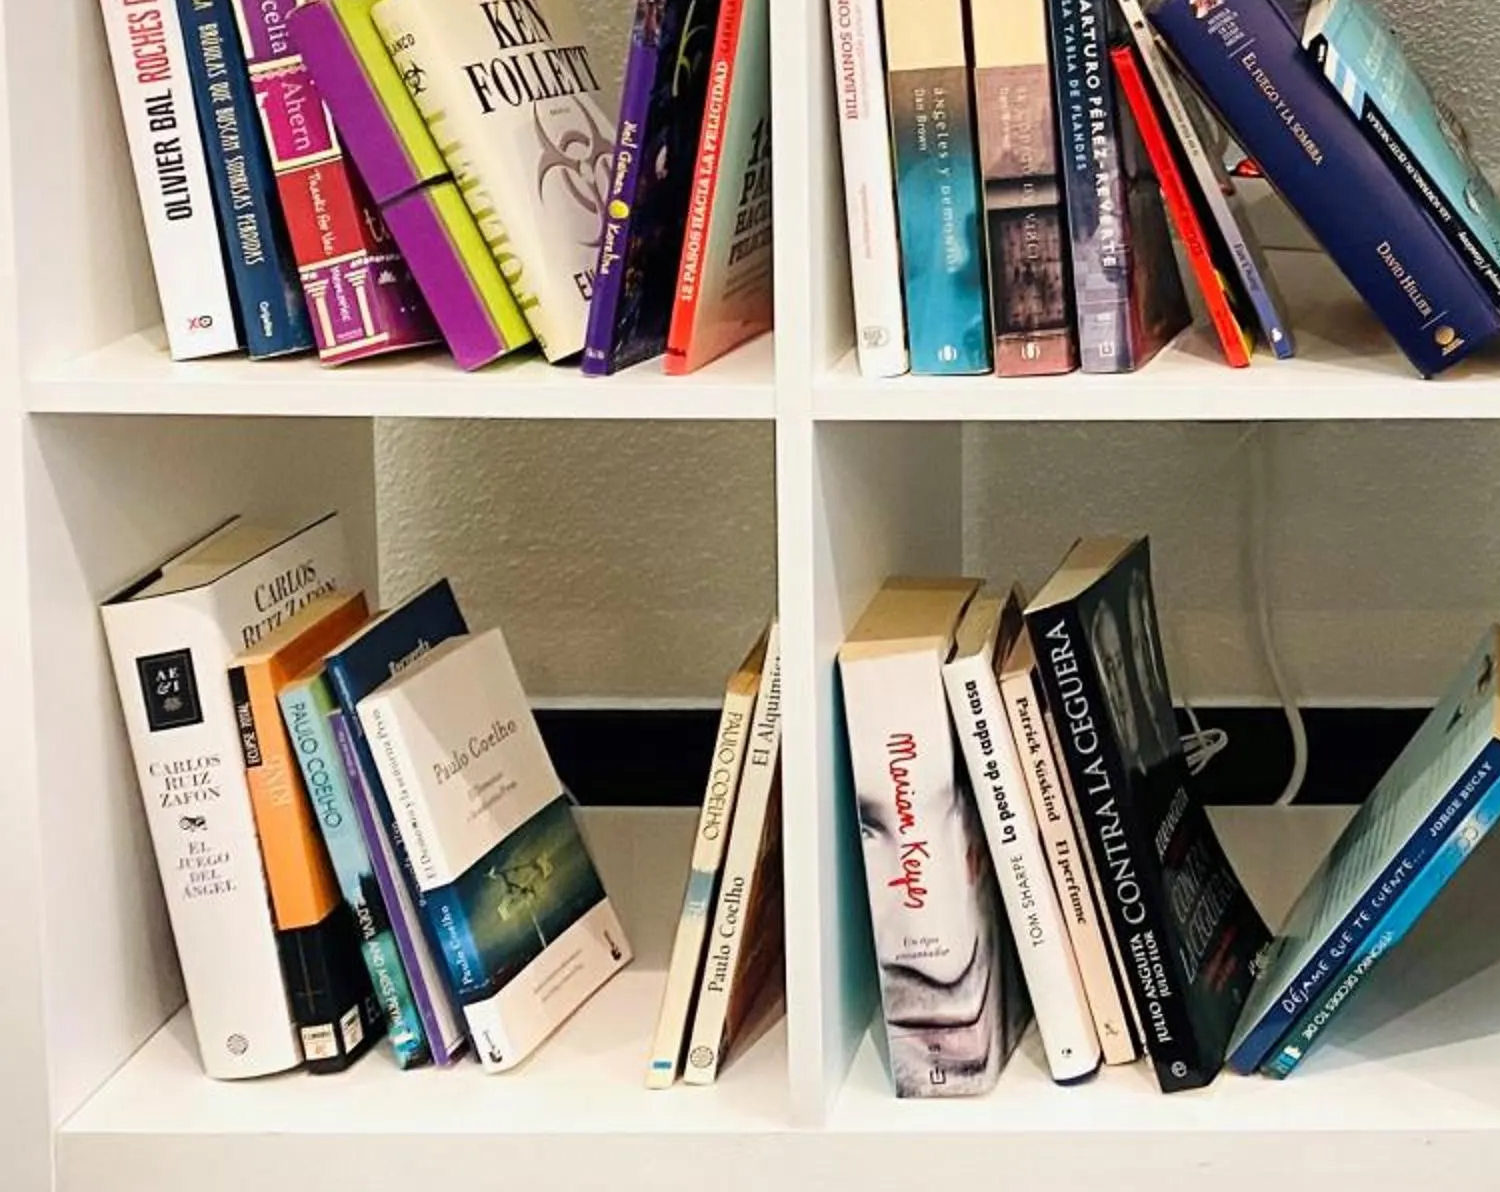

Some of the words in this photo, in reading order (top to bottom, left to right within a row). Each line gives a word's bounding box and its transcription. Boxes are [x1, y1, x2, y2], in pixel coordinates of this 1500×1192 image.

[1061, 0, 1073, 18] LA
[128, 9, 172, 84] ROCHES
[1063, 23, 1078, 73] TABLA
[1079, 0, 1100, 90] ARTURO
[463, 46, 601, 115] FOLLETT
[840, 32, 859, 120] BILBAINOS
[914, 88, 926, 112] Dan
[1068, 79, 1081, 98] DE
[145, 88, 177, 132] BAL
[281, 82, 311, 151] Ahern
[704, 61, 728, 151] FELICIDAD
[915, 115, 929, 151] Brown
[1250, 67, 1281, 103] FUEGO
[1278, 107, 1296, 125] LA
[1288, 121, 1325, 165] SOMBRA
[701, 147, 715, 178] LA
[1071, 105, 1087, 171] FLANDES
[154, 137, 193, 221] OLIVIER
[690, 178, 710, 233] HACIA
[1089, 95, 1117, 267] PÉREZ-REVERTE
[682, 230, 701, 284] PASOS
[1374, 240, 1408, 279] DAVID
[1397, 274, 1436, 317] HILLIER
[254, 559, 317, 613] CARLOS
[965, 679, 983, 715] casa
[1045, 618, 1099, 757] CEGUERA
[433, 750, 468, 785] Paulo
[468, 719, 518, 759] Coelho
[716, 711, 743, 765] PAULO
[973, 719, 994, 757] cada
[1015, 697, 1042, 756] Patrick
[149, 756, 221, 776] CARLOS
[164, 772, 212, 792] RUIZ
[289, 701, 318, 755] PAULO
[307, 757, 342, 829] COELHO
[752, 747, 769, 767] El
[886, 732, 918, 836] Marian
[983, 759, 1000, 783] de
[1083, 755, 1112, 797] LA
[703, 768, 732, 840] COELHO
[993, 783, 1016, 821] peor
[177, 853, 230, 870] JUEGO
[188, 841, 212, 855] EL
[1002, 826, 1017, 845] Lo
[1055, 839, 1070, 856] El
[1095, 797, 1147, 926] CONTRA
[189, 869, 221, 883] DEL
[887, 840, 931, 910] Keyes
[1009, 854, 1036, 911] SHARPE
[1058, 857, 1088, 925] perfume
[1281, 958, 1330, 1015] DÉJAME
[1330, 933, 1354, 958] QUE
[1353, 910, 1371, 929] TE
[1429, 799, 1462, 837] JORGE
[1461, 760, 1493, 800] BUCAY
[434, 904, 463, 951] Coelho
[707, 944, 731, 992] Paulo
[719, 875, 744, 938] Coelho
[1027, 912, 1045, 949] TOM
[1143, 928, 1161, 962] FLOR
[368, 941, 385, 968] AND
[377, 968, 396, 996] MISS
[451, 949, 475, 985] Paulo
[1130, 932, 1160, 1000] ANGUITA
[1154, 961, 1173, 998] JULIO
[1325, 972, 1360, 1011] DECIDES
[1148, 999, 1173, 1043] JULIO
